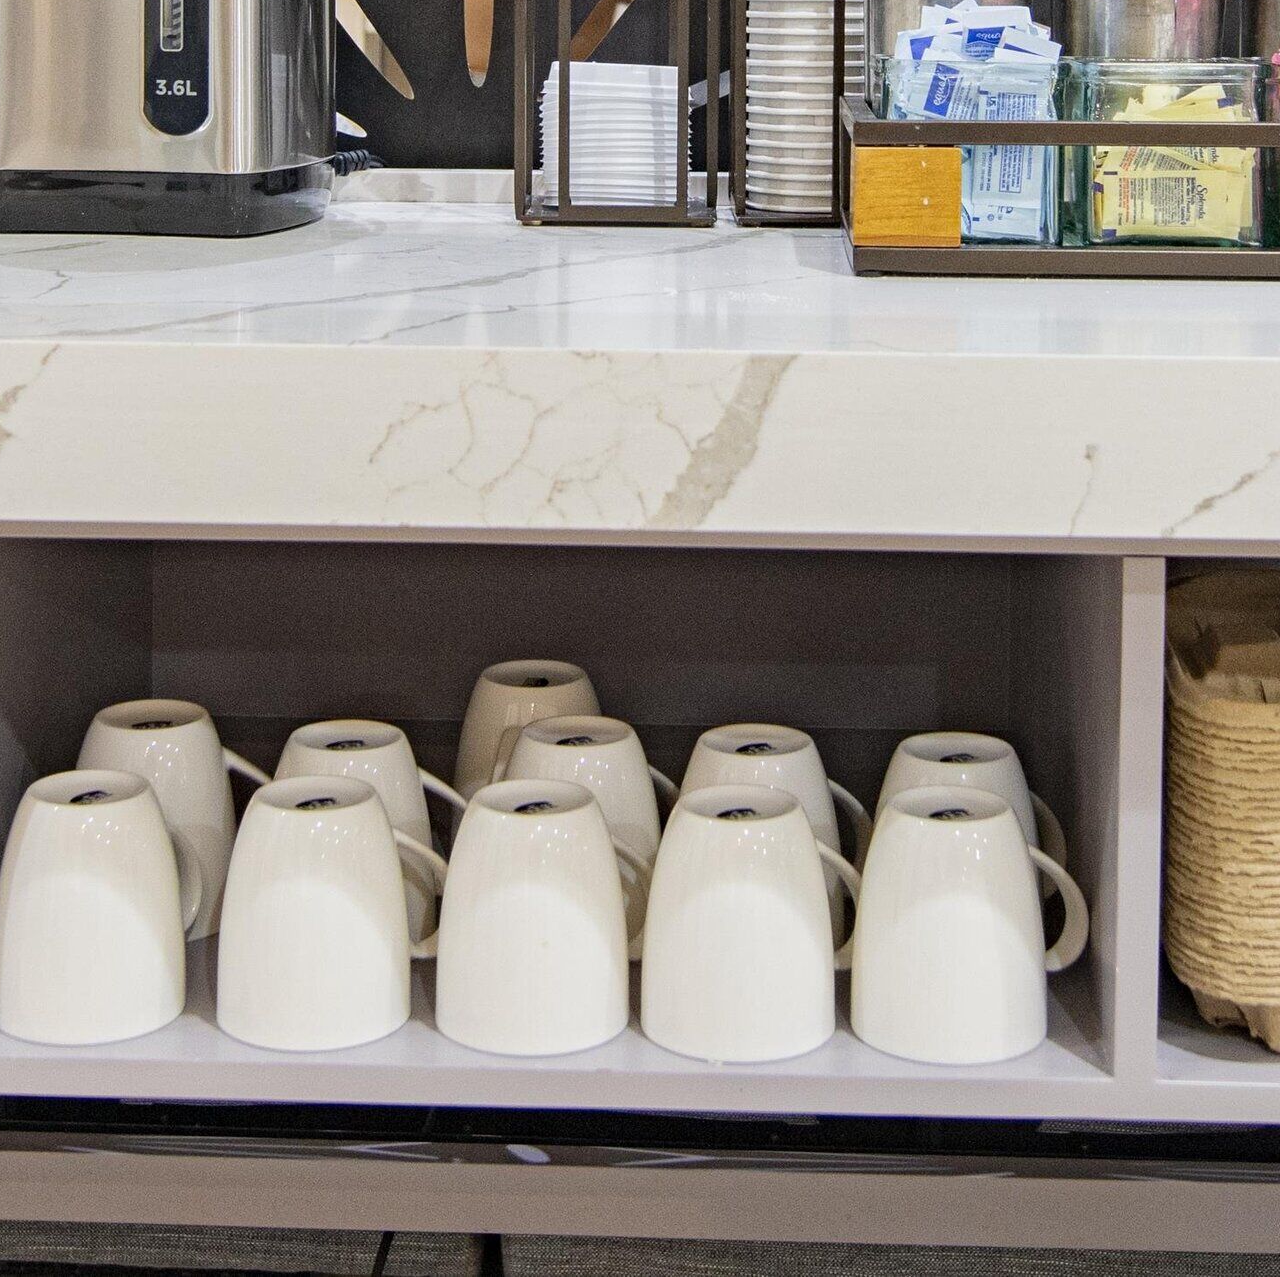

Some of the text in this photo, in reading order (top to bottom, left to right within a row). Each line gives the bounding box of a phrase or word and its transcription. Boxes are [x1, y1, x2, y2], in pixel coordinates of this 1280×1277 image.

[975, 31, 1001, 41] equa
[155, 79, 198, 96] 3.6L
[1195, 184, 1209, 219] Splenda
